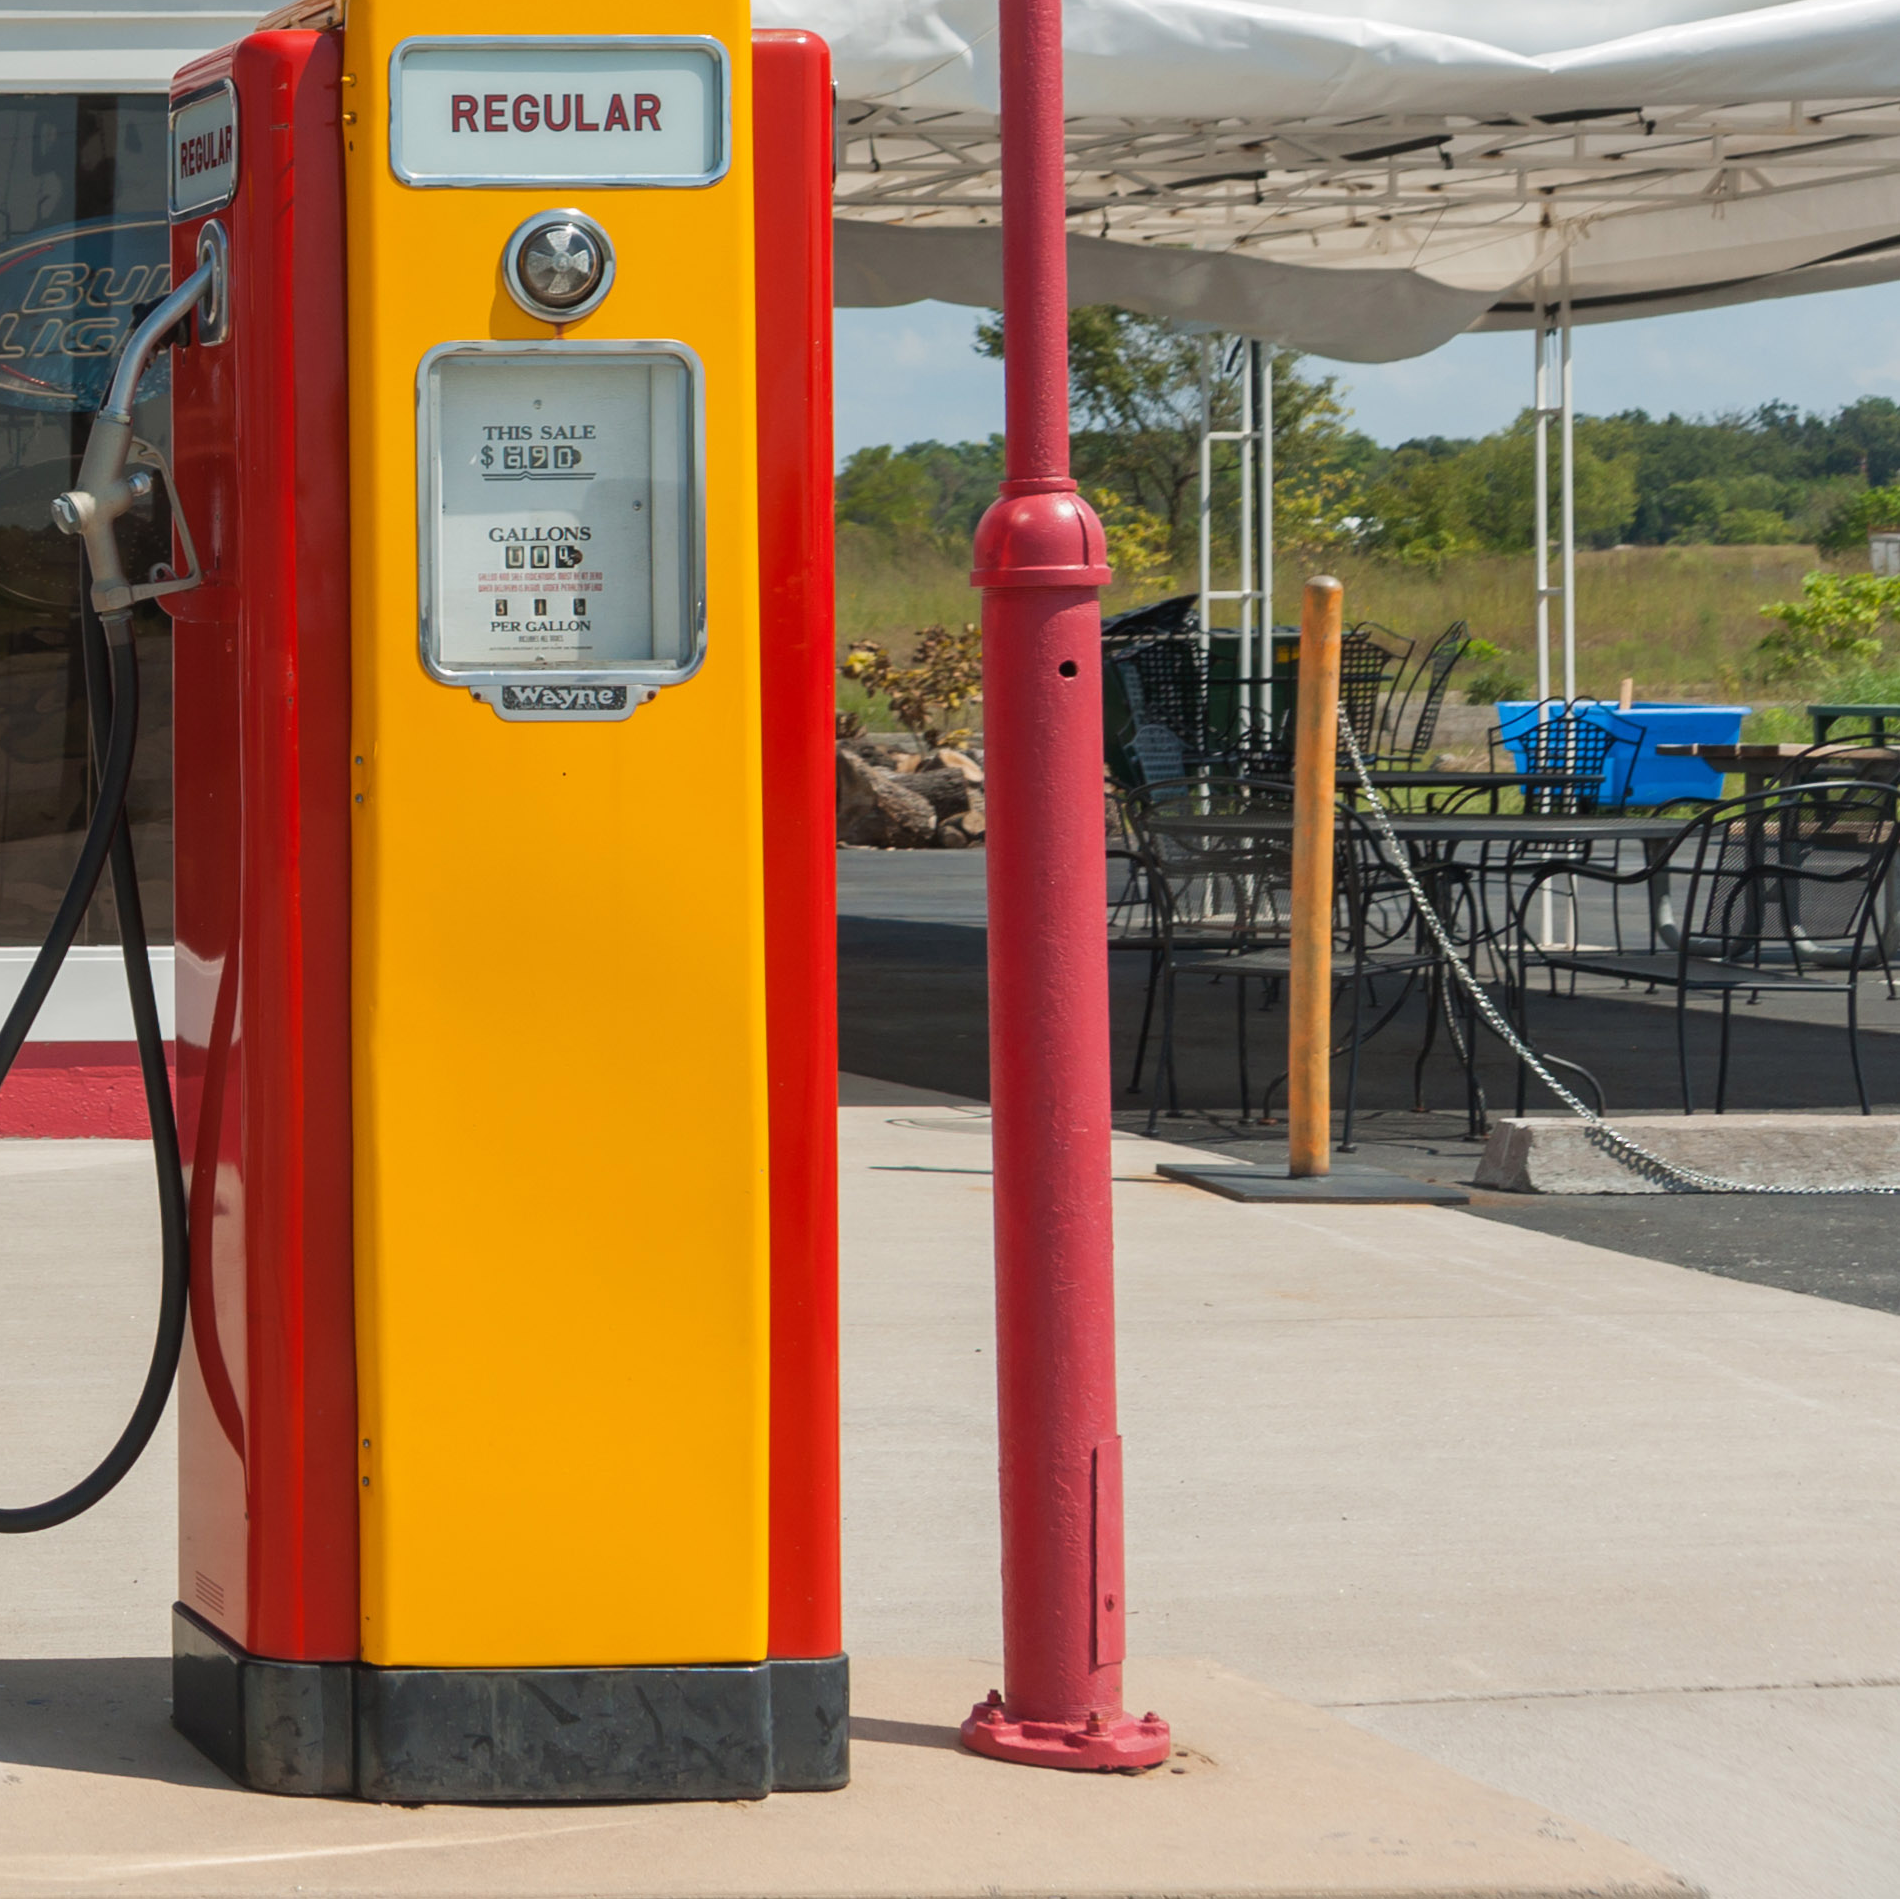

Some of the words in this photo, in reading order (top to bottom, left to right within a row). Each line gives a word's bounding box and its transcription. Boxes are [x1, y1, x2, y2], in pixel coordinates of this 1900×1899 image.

[451, 93, 662, 133] REGULAR
[180, 125, 233, 180] REGULAR
[482, 425, 533, 441] THIS
[540, 425, 597, 440] SALE
[488, 526, 592, 542] GALLONS
[490, 621, 521, 632] PER
[525, 620, 592, 632] GALLON
[510, 686, 614, 709] Wayne
